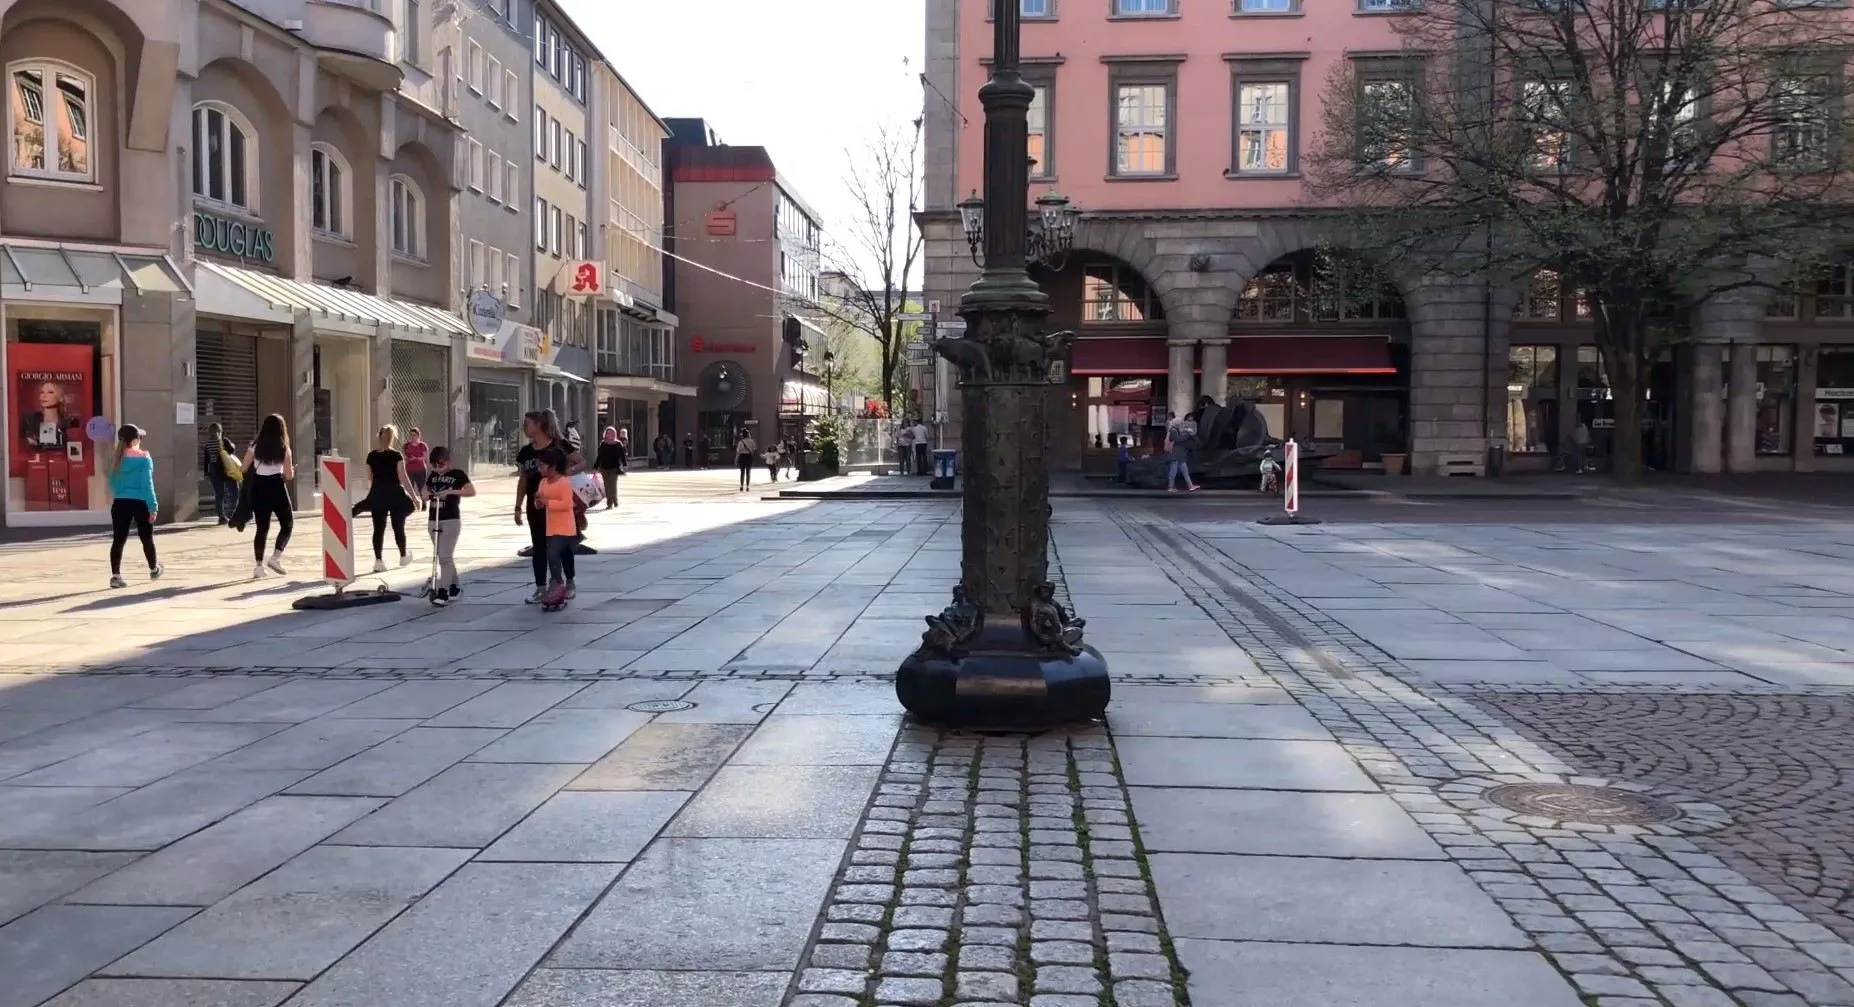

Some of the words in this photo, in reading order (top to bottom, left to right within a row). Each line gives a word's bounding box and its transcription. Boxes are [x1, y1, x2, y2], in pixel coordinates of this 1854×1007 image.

[194, 212, 274, 262] DOUGLAS
[21, 371, 53, 381] GIORGIO
[55, 371, 83, 381] ARMANI
